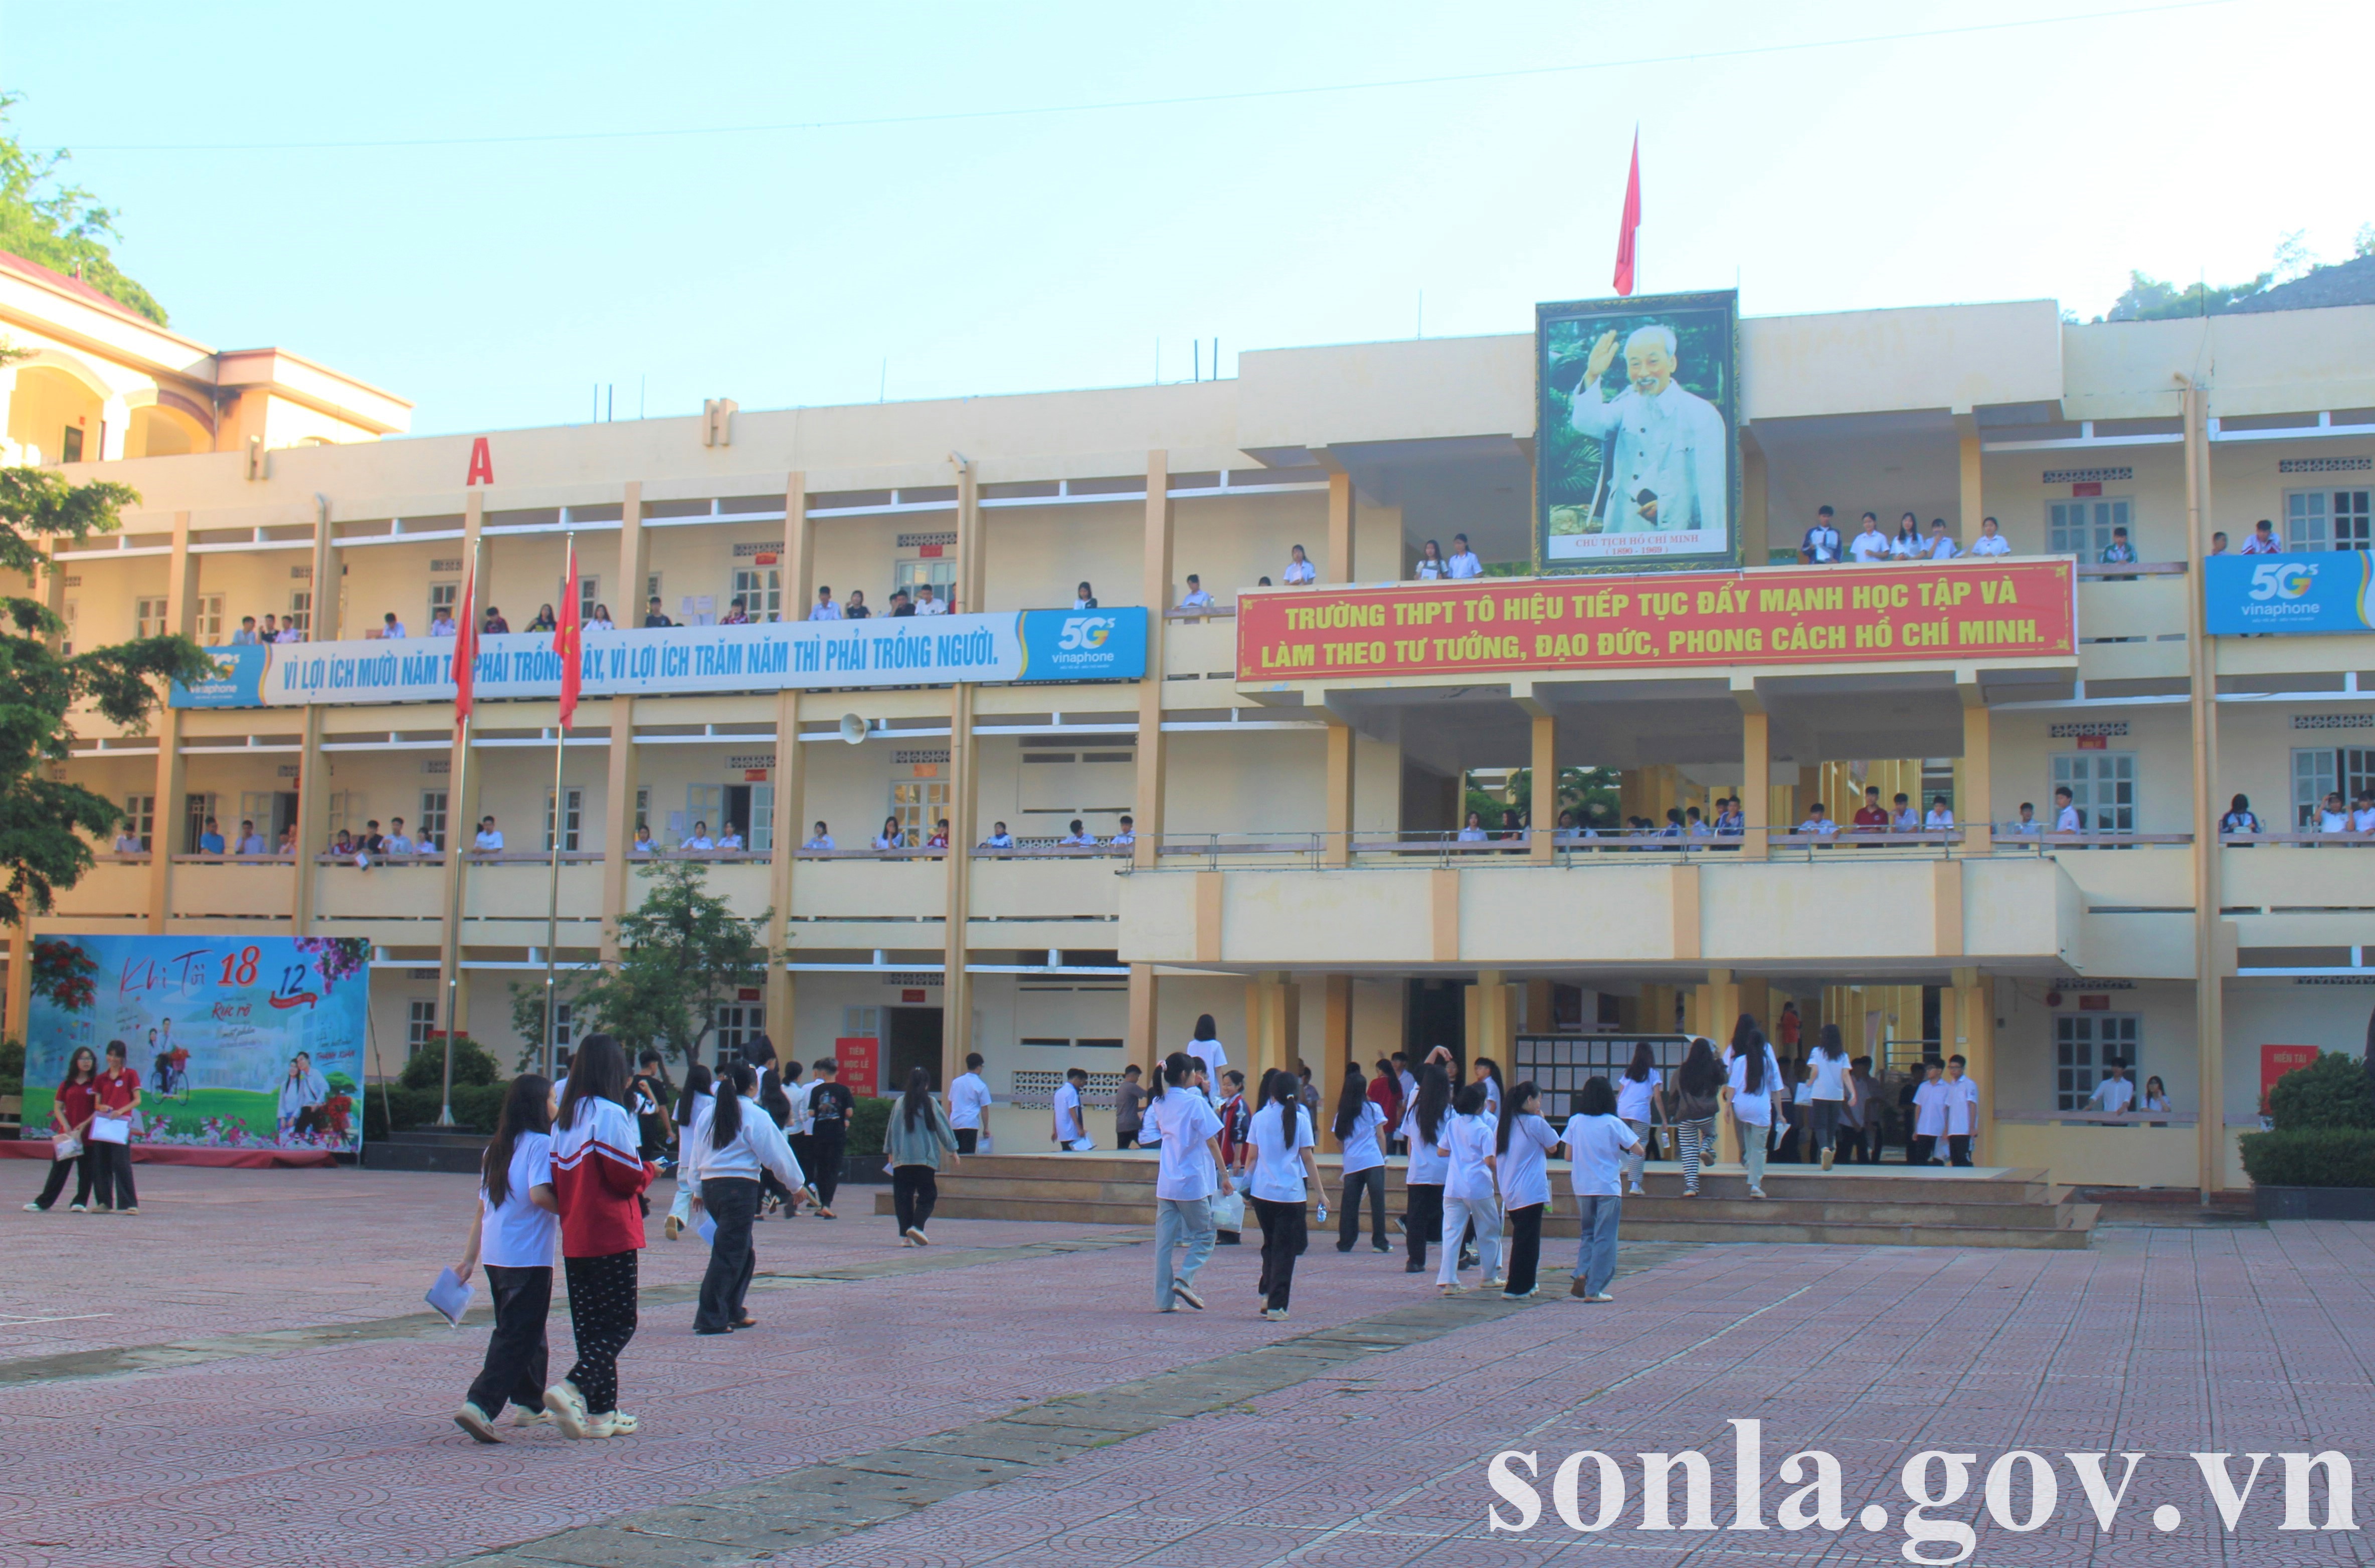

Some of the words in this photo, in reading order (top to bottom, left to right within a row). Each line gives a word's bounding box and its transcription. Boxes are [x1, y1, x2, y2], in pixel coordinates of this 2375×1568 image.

[466, 437, 494, 486] A
[1576, 536, 1598, 547] CHỦ
[1602, 536, 1626, 548] TỊCH
[1648, 534, 1667, 544] CHÍ
[1670, 534, 1699, 543] MINH
[1285, 601, 1385, 630] TRƯỜNG
[1393, 601, 1455, 625] THPT
[1464, 595, 1495, 622] TÔ
[1504, 593, 1564, 625] HIỆU
[1572, 587, 1629, 618] TIẾP
[1638, 592, 1689, 621] TỤC
[1697, 581, 1750, 615] ĐẨY
[1760, 586, 1843, 617] MẠNH
[1853, 584, 1909, 614] HỌC
[1918, 577, 1971, 611] TẬP
[1980, 575, 2018, 604] VÀ
[2241, 603, 2320, 617] vinaphone
[284, 655, 297, 690] VÌ
[301, 658, 324, 696] LỢI
[328, 654, 354, 688] ÍCH
[356, 650, 398, 687] MƯỜI
[401, 651, 438, 685] NĂM
[580, 643, 604, 684] ÂY,
[611, 642, 626, 679] VÌ
[630, 645, 656, 685] LỢI
[661, 640, 689, 677] ÍCH
[695, 638, 742, 676] TRĂM
[748, 636, 788, 674] NĂM
[794, 634, 821, 672] THÌ
[826, 628, 867, 671] PHẢI
[873, 626, 932, 669] TRỒNG
[937, 626, 998, 667] NGƯỜI.
[1052, 652, 1114, 664] vinaphone
[1261, 641, 1315, 668] LÀM
[1323, 642, 1386, 666] THEO
[1394, 638, 1428, 663] TƯ
[1433, 630, 1527, 661] TƯỞNG,
[1535, 633, 1589, 662] ĐẠO
[1597, 627, 1660, 657] ĐỨC,
[1669, 628, 1762, 654] PHONG
[1771, 622, 1846, 650] CÁCH
[1856, 616, 1893, 648] HỒ
[1902, 617, 1949, 647] CHÍ
[1959, 619, 2045, 645] MINH.
[218, 945, 261, 987] 18
[280, 964, 306, 996] 12
